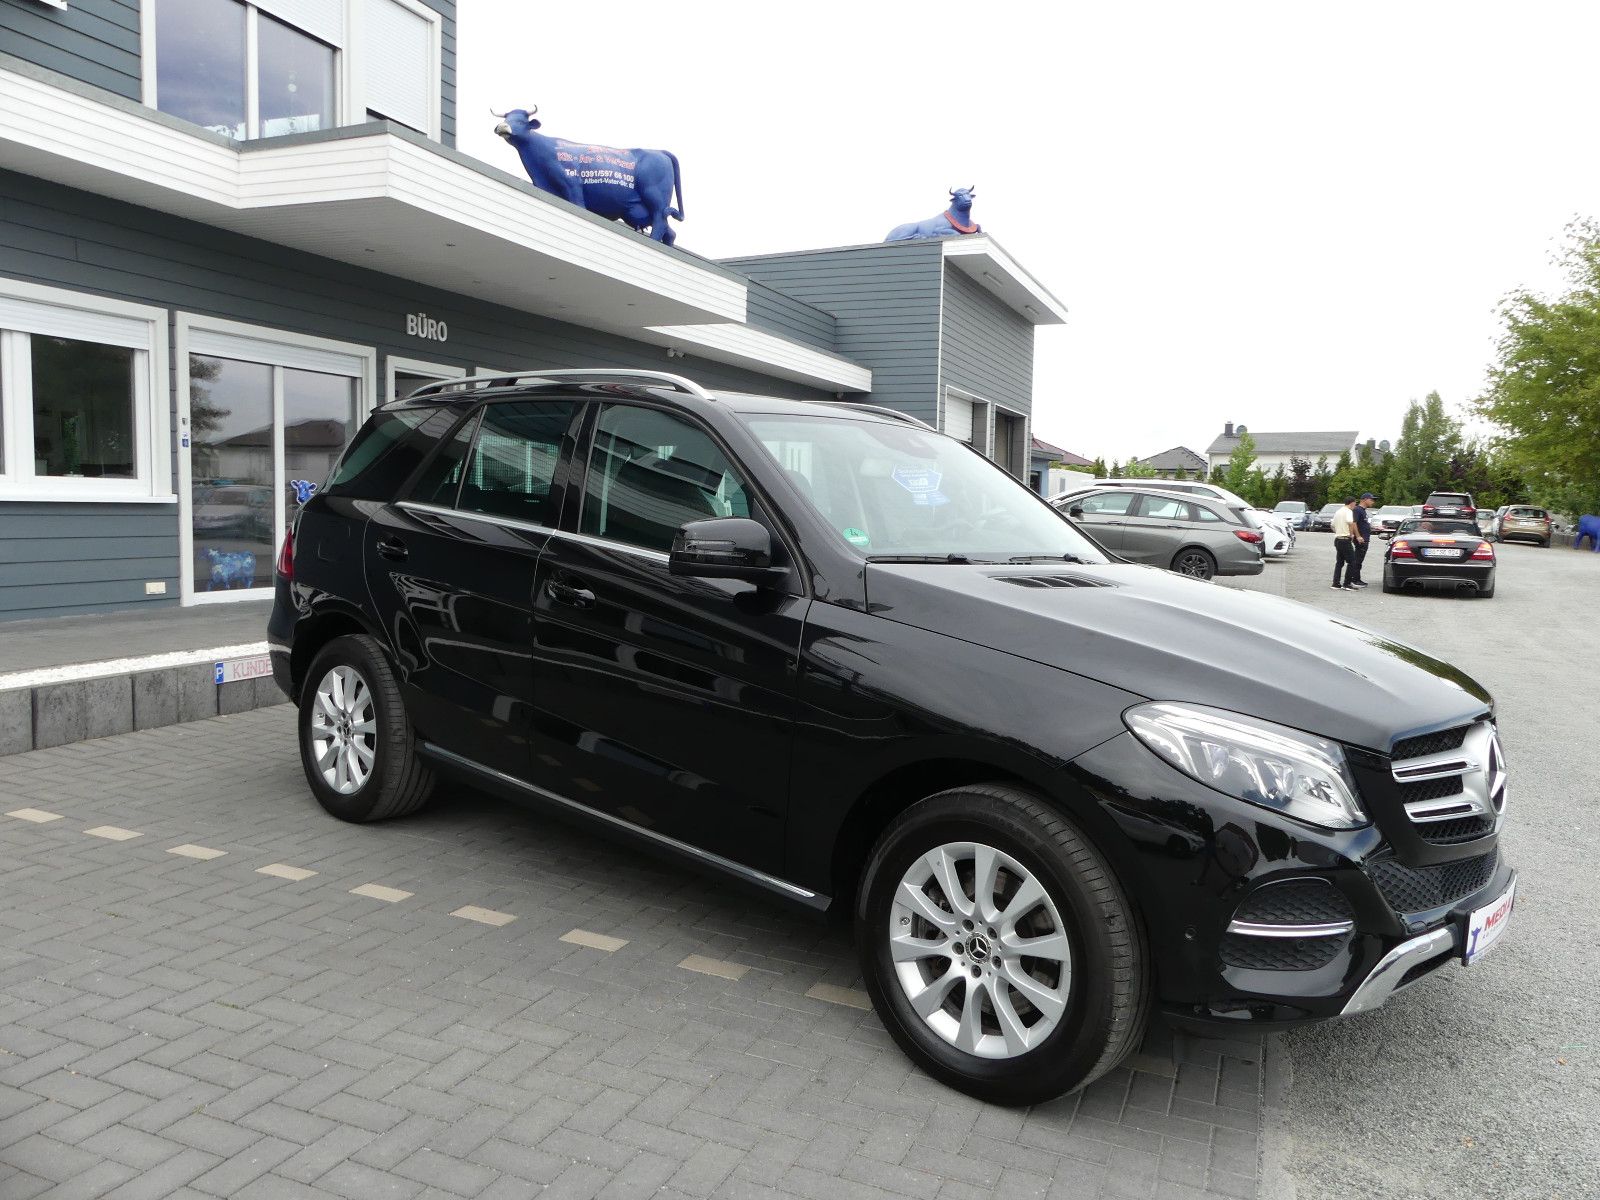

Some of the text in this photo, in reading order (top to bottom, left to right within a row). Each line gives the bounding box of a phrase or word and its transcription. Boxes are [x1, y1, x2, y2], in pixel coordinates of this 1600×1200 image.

[565, 169, 579, 177] Tel.
[581, 169, 612, 178] 0391/597
[406, 312, 448, 342] BÜRO
[216, 659, 272, 680] P KUNDE
